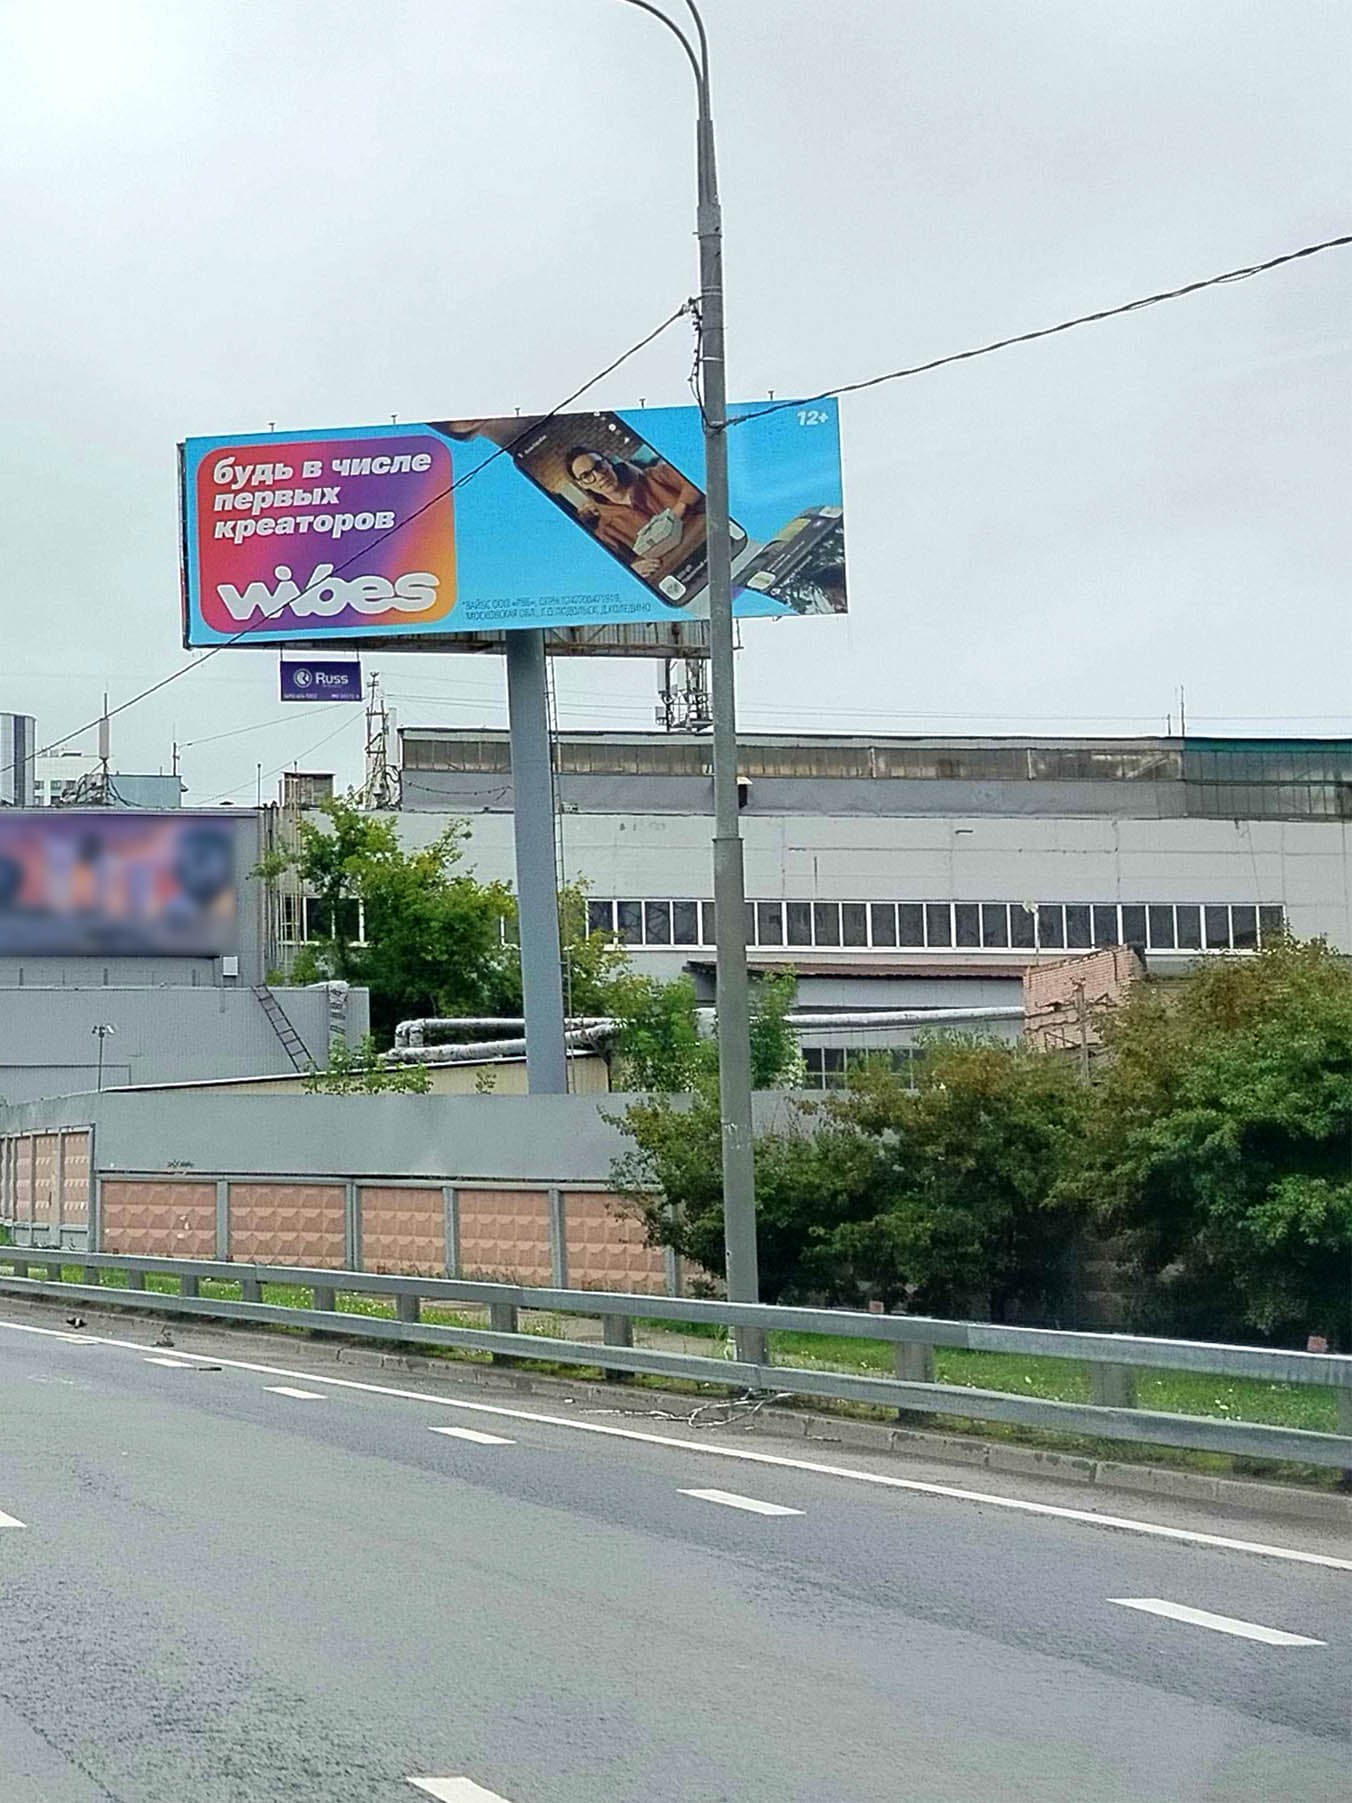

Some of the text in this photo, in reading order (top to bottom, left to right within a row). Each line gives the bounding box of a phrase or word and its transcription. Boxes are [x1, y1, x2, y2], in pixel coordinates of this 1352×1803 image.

[797, 410, 828, 426] 12+
[213, 453, 431, 490] будь в числе
[213, 486, 341, 516] первых
[213, 511, 395, 545] креаторов
[216, 563, 440, 621] wibes
[315, 672, 349, 685] Russ
